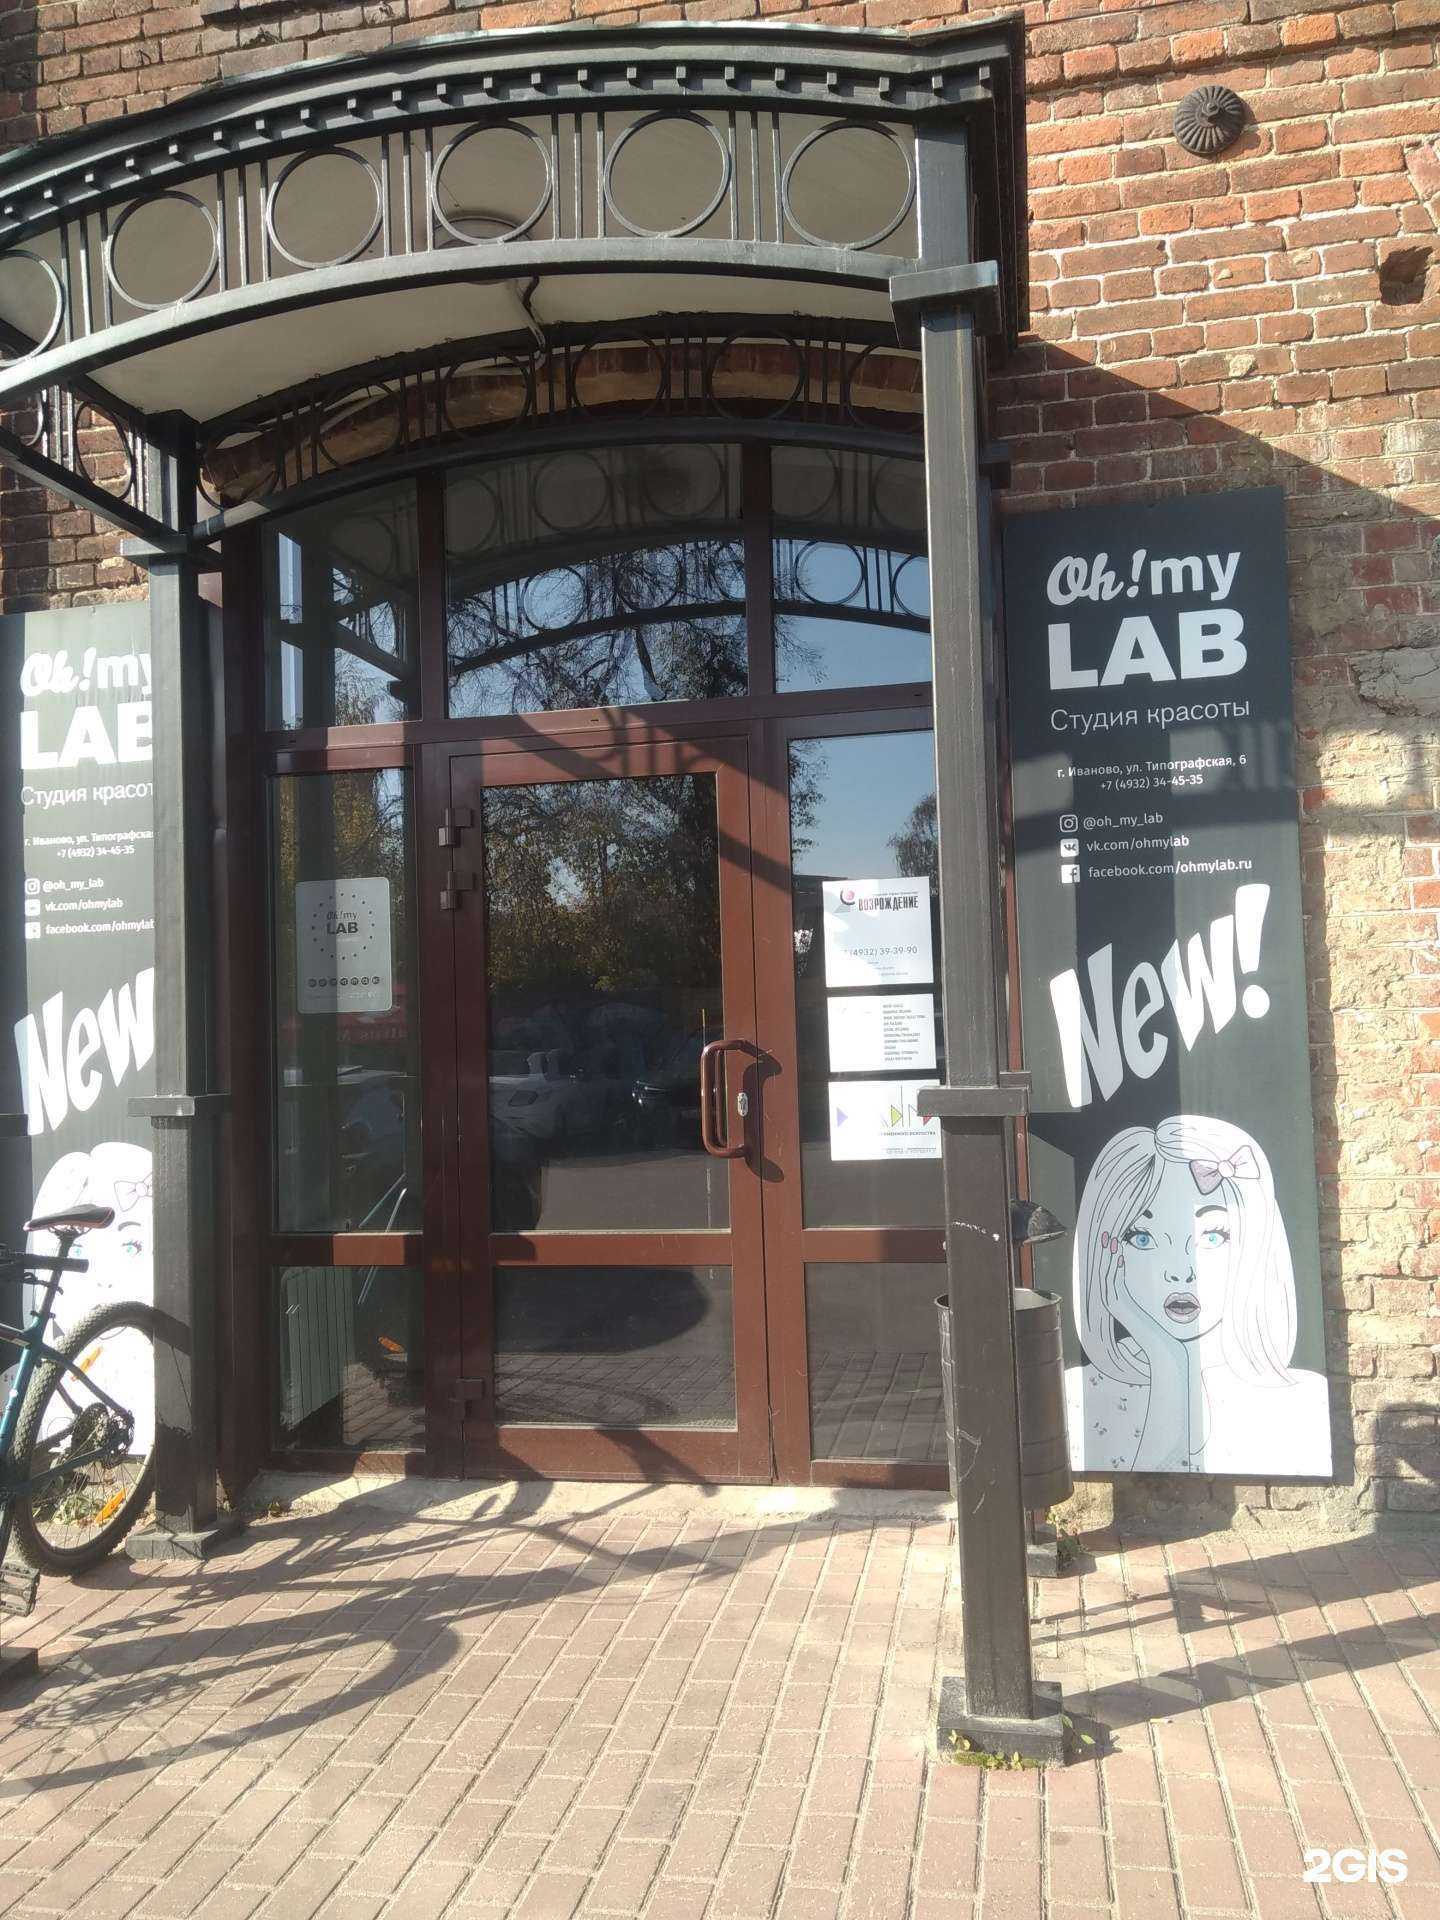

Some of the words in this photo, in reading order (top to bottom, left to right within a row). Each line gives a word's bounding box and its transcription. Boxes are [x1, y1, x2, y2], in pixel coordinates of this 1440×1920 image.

[1048, 608, 1248, 690] LAB
[1050, 709, 1138, 736] Студия
[1147, 700, 1250, 729] красоты
[20, 700, 153, 770] LAB
[1068, 764, 1123, 777] Иваново,
[1126, 763, 1142, 775] ул.
[1239, 754, 1247, 765] 6
[1115, 776, 1150, 791] (4932)
[1153, 774, 1204, 787] 34-45-35
[20, 785, 87, 810] Студия
[93, 782, 153, 806] красот
[1083, 812, 1164, 830] @oh_my_lab
[1086, 835, 1190, 852] vk.com/ohmylab
[1087, 858, 1253, 878] facebook.com/ohmylab.ru
[44, 897, 124, 913] vk.com/ohmylab
[858, 895, 919, 911] ВОЗРОЖДЕНИЕ
[327, 921, 358, 935] LAB
[14, 966, 154, 1136] New
